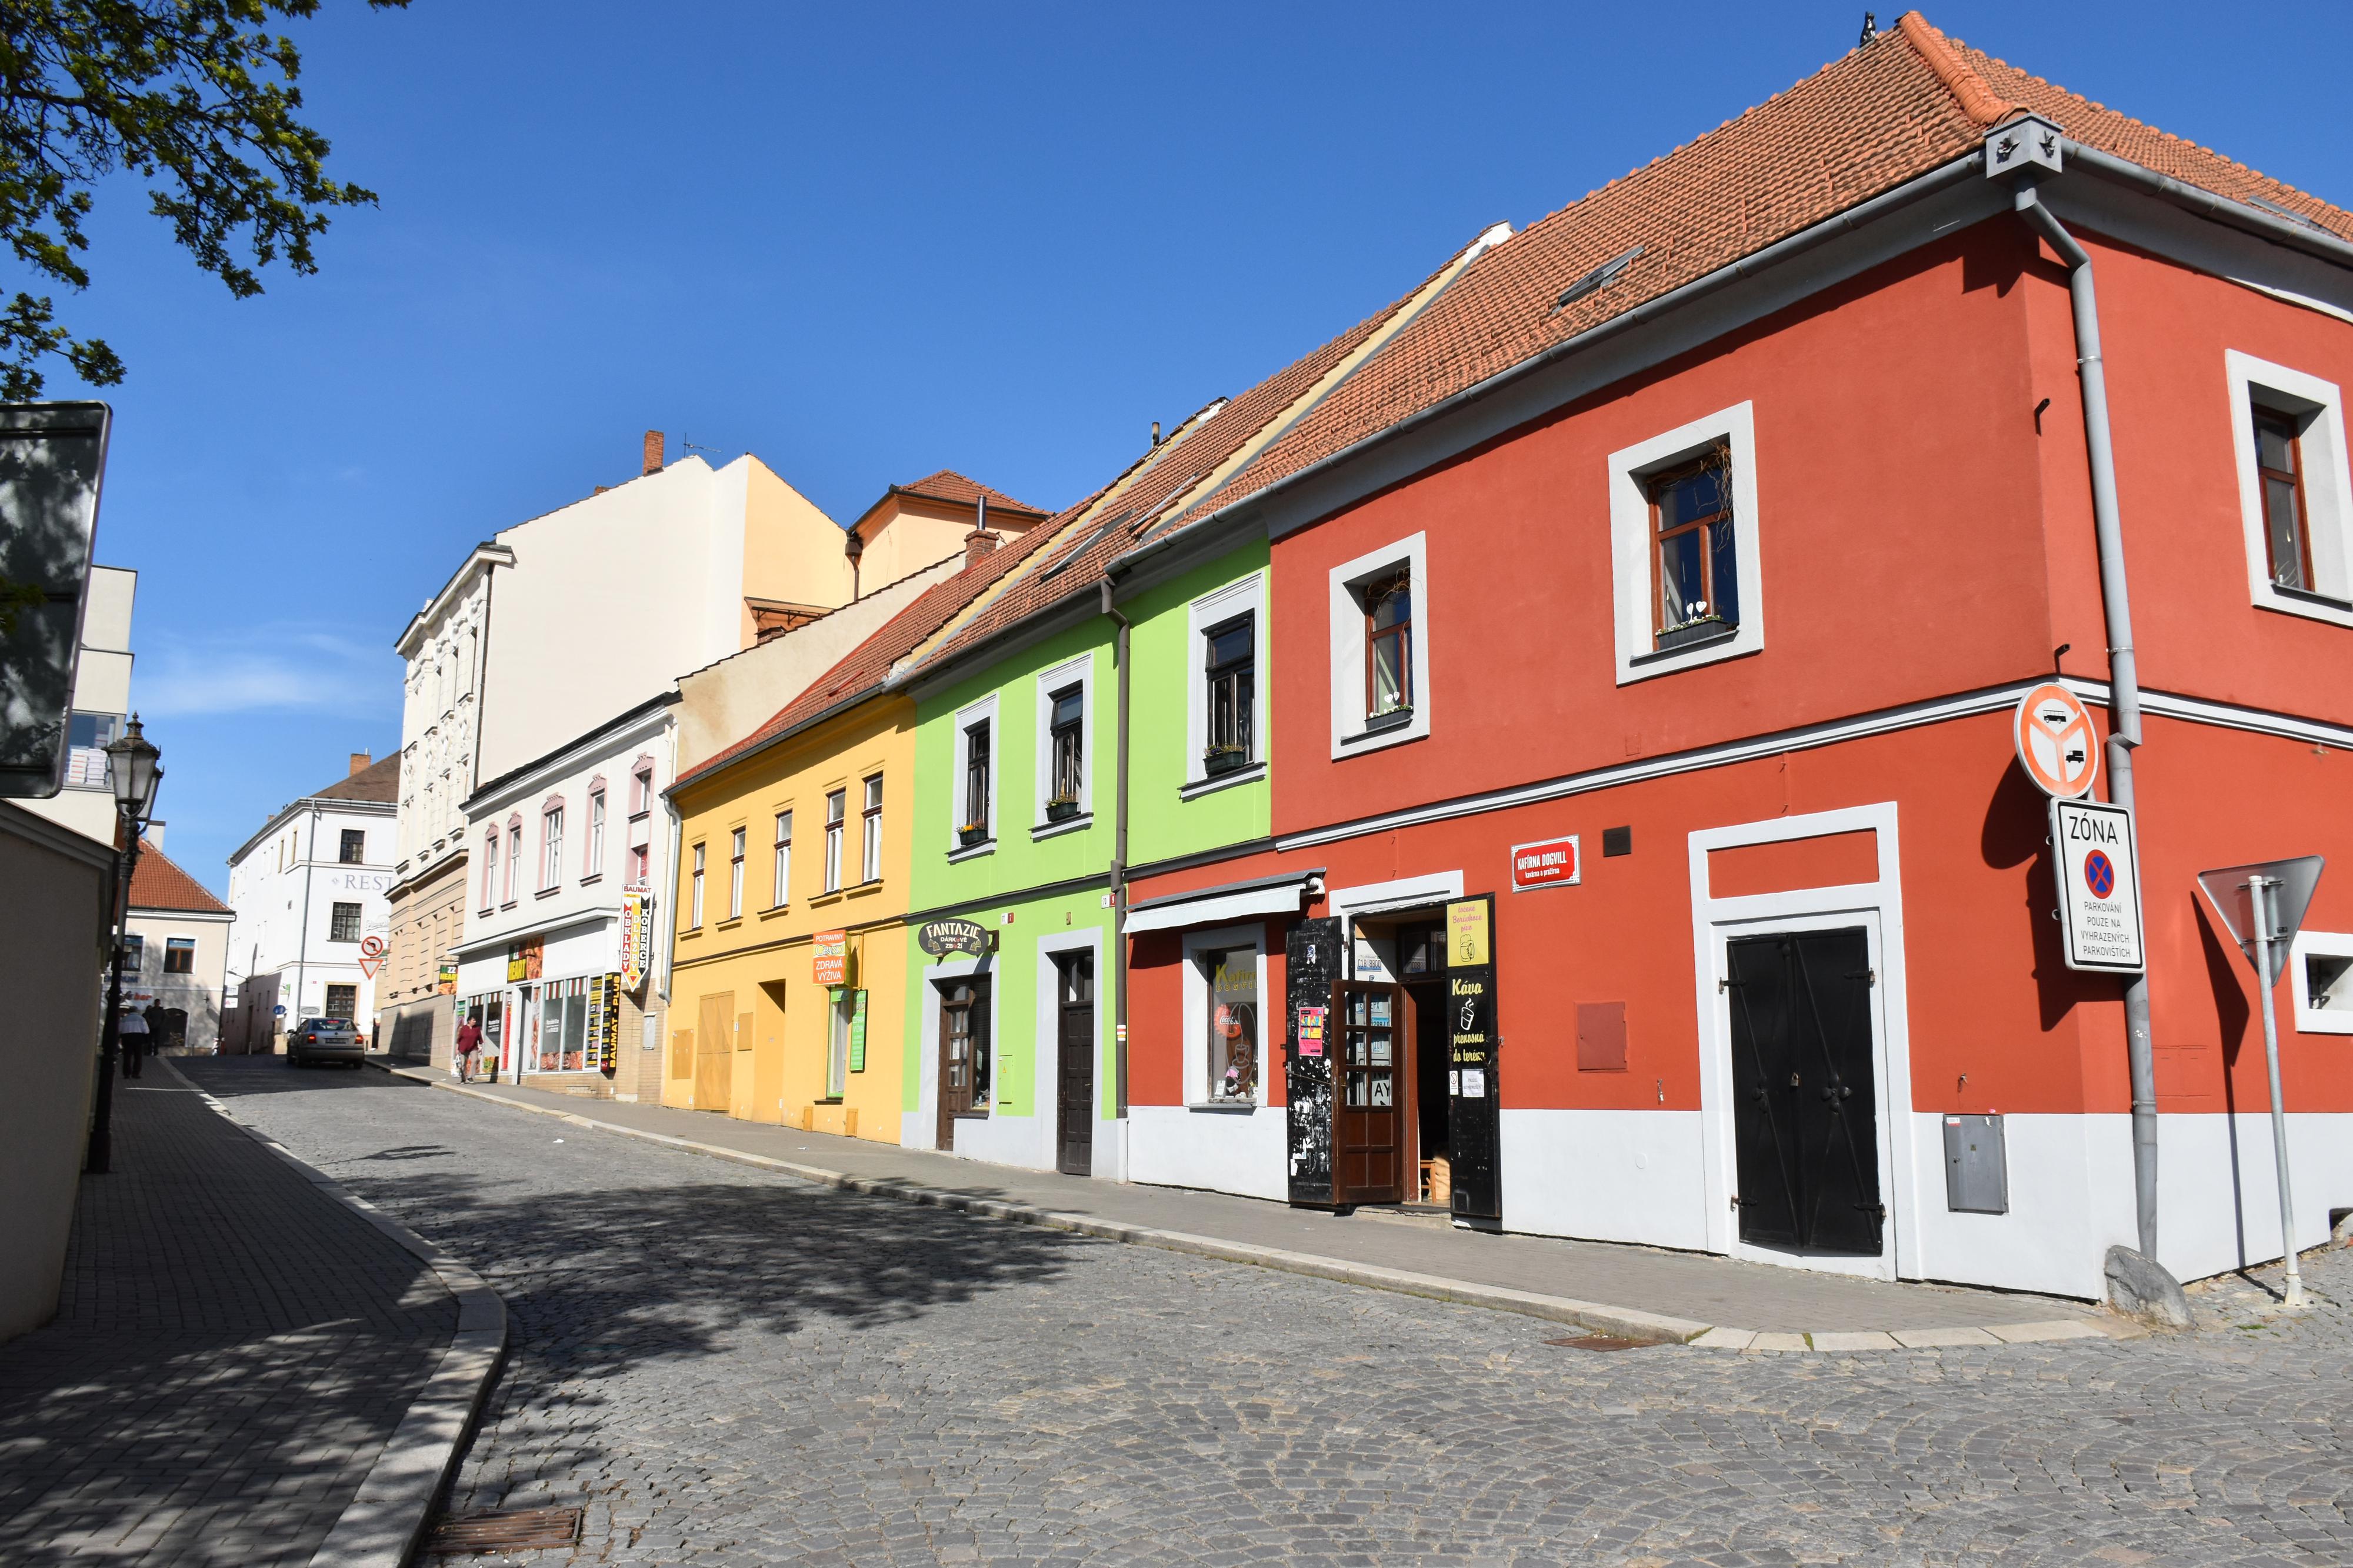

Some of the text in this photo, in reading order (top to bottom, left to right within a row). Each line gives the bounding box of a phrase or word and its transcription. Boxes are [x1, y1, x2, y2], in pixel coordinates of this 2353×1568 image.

[2069, 812, 2118, 845] ZÓNA
[1518, 851, 1567, 870] KAFÍRNA DOGVILL
[2084, 901, 2122, 913] PARKOVÁNÍ
[2087, 916, 2121, 928] POUZE NA
[815, 933, 843, 942] POTRAVINY
[926, 922, 982, 939] FANTAZIE
[2081, 930, 2129, 943] VYHRAZENÝCH
[623, 910, 632, 969] OBKLADY
[639, 908, 649, 968] KOBERCE
[2083, 945, 2131, 958] PARKOVIŠTÍCH
[815, 958, 843, 970] ZDRAVÁ
[818, 970, 842, 981] VÝŽIVA
[1452, 978, 1483, 996] Káva
[609, 1017, 618, 1068] BAUMAT
[1453, 1031, 1485, 1047] přenosná
[1453, 1049, 1462, 1062] do
